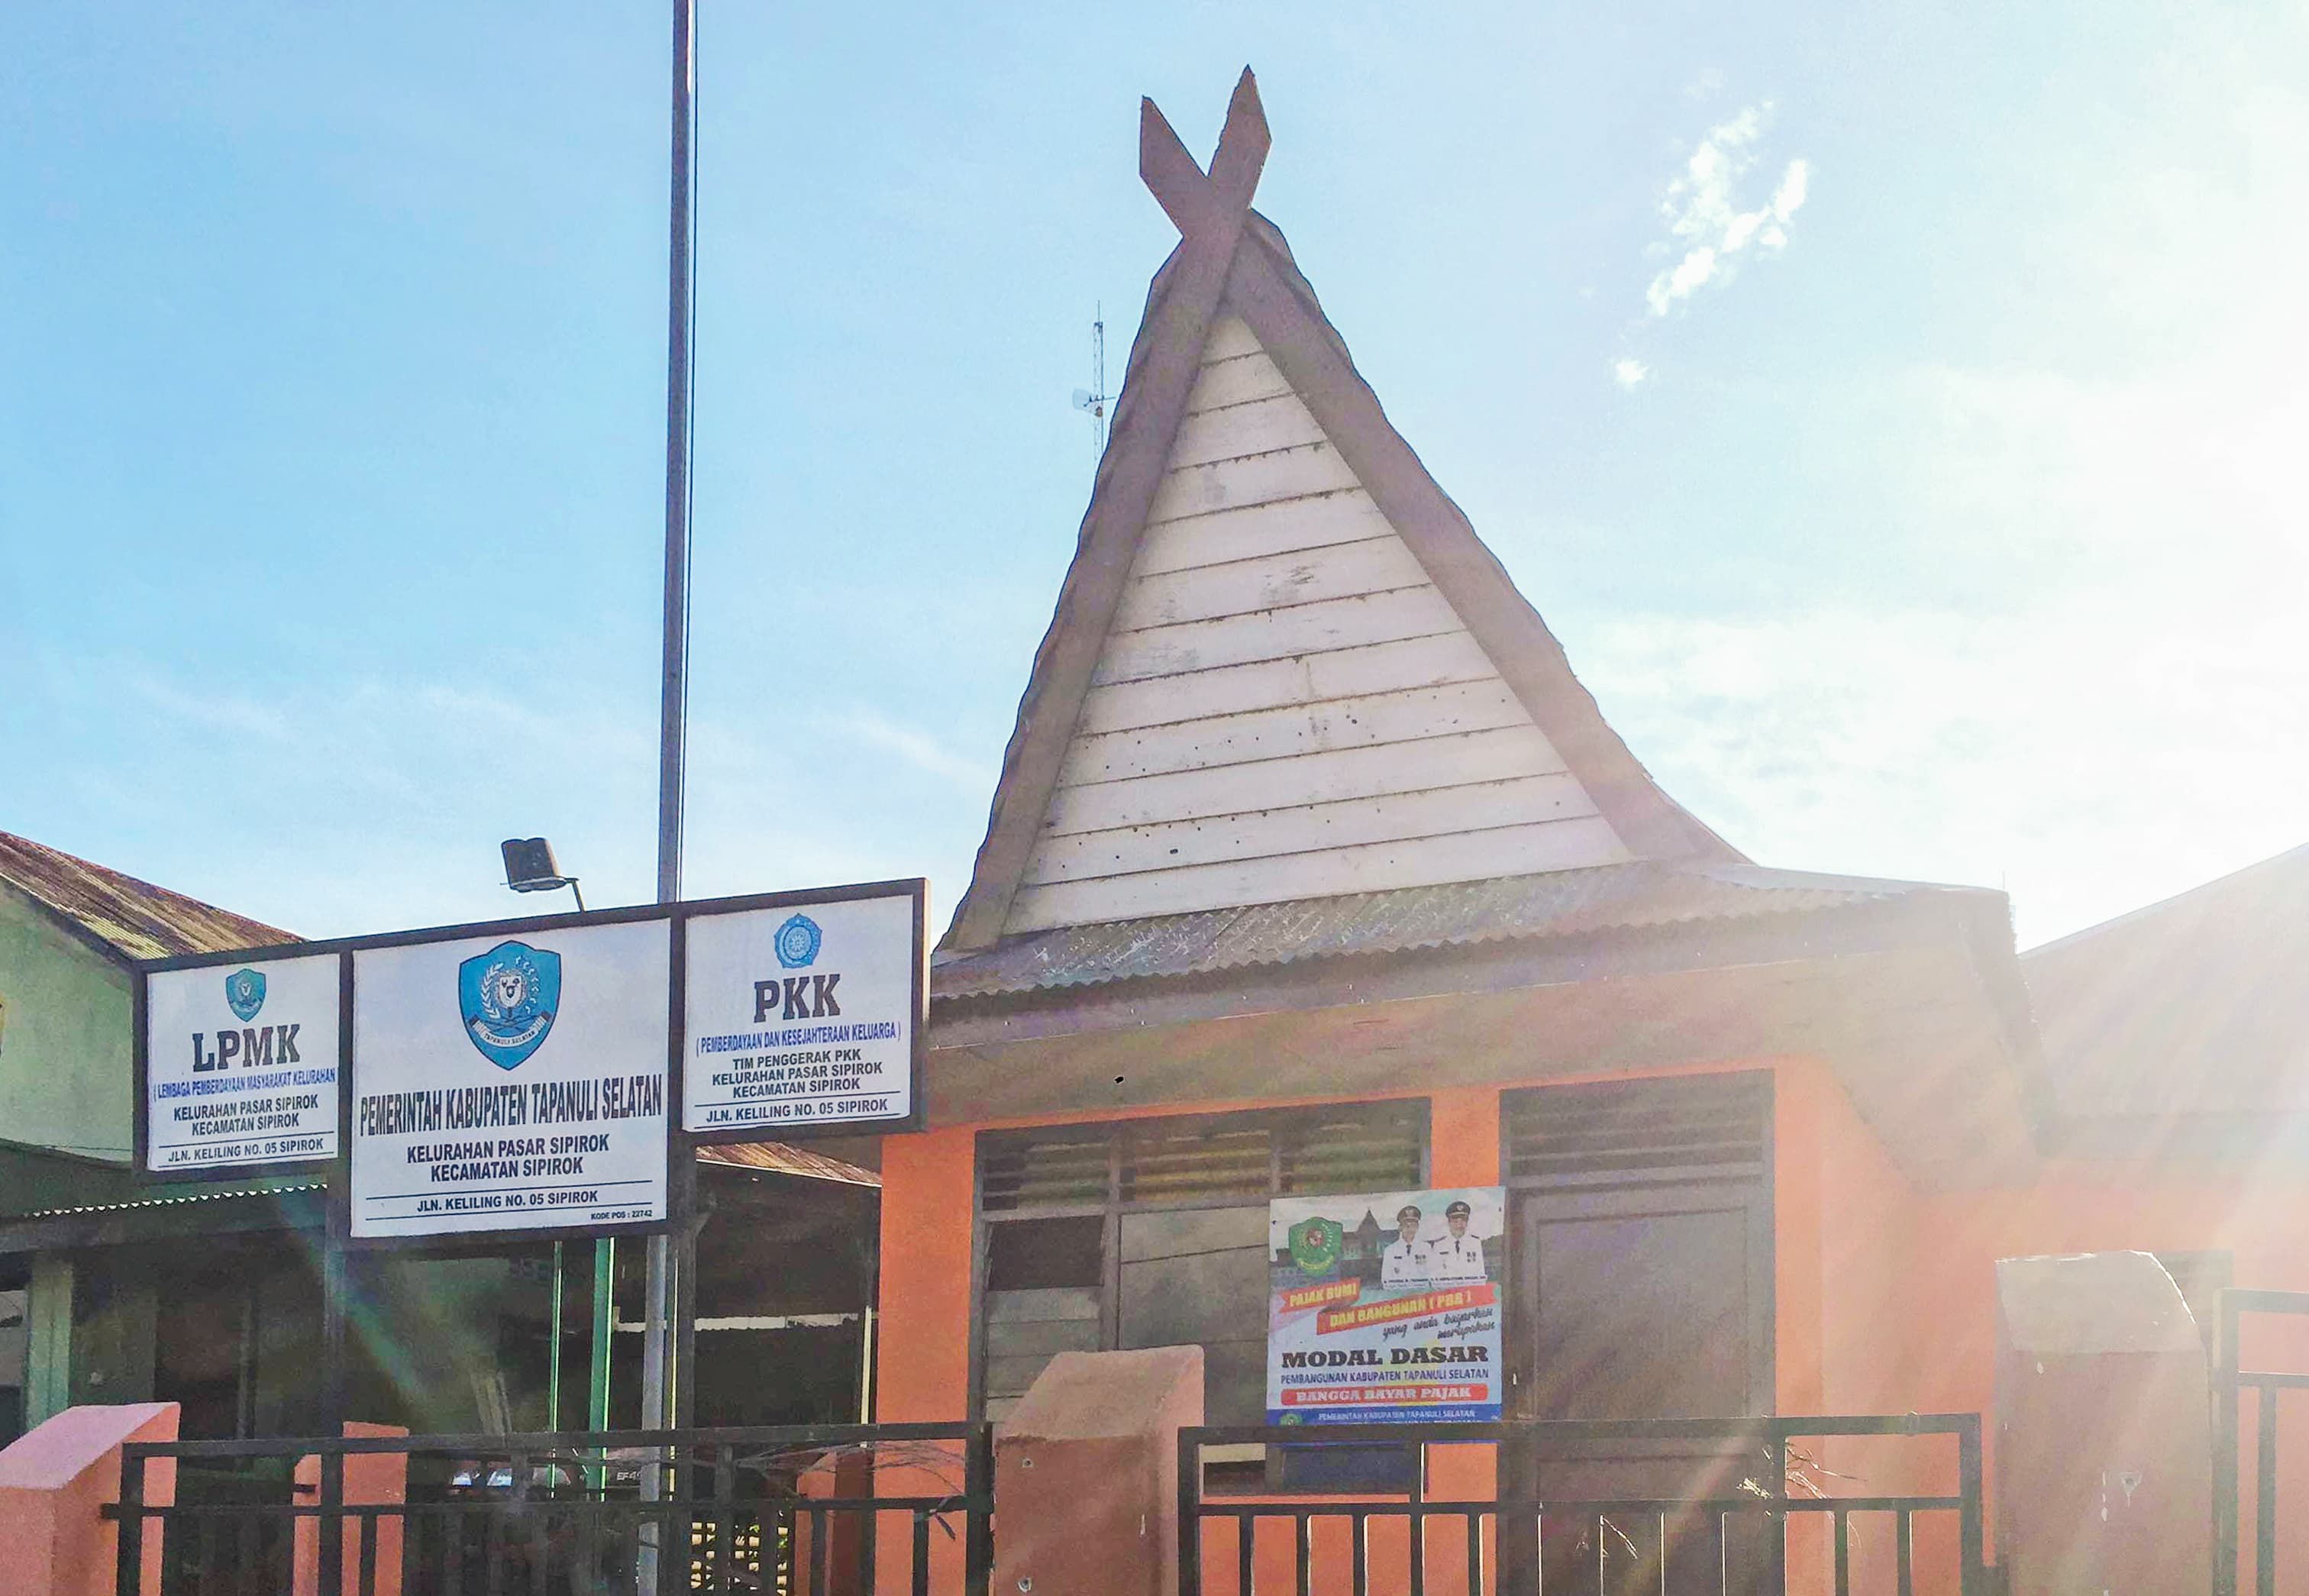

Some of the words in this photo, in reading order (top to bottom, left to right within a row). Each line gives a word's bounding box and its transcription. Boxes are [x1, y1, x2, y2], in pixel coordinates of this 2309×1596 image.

[754, 974, 840, 1023] PKK
[764, 1032, 780, 1048] DAN
[782, 1026, 849, 1046] KESEJAHTERAAN
[852, 1023, 896, 1040] KELUARGA
[192, 1024, 300, 1072] LPMK
[733, 1058, 754, 1070] TIM
[757, 1051, 831, 1068] PENGGERAK
[835, 1048, 861, 1061] PKK
[158, 1081, 190, 1098] LEMBAGA
[192, 1077, 244, 1095] PEMBERDAYAAN
[247, 1071, 291, 1090] MASYARAKAT
[293, 1068, 335, 1085] KELURAHAN
[712, 1071, 784, 1085] KELURAHAN
[788, 1066, 828, 1079] PASAR
[832, 1062, 883, 1075] SIPIROK
[733, 1082, 805, 1098] KECAMATAN
[809, 1078, 861, 1091] SIPIROK
[174, 1103, 237, 1121] KELURAHAN
[240, 1098, 272, 1115] PASAR
[276, 1094, 318, 1110] SIPIROK
[360, 1090, 441, 1137] PEMERINTAH
[446, 1084, 527, 1130] KABUPATEN
[532, 1079, 598, 1124] TAPANULI
[602, 1074, 662, 1118] SELATAN
[706, 1110, 732, 1123] JLN.
[736, 1106, 790, 1120] KELILING
[795, 1104, 815, 1115] NO.
[820, 1103, 834, 1113] 05
[838, 1099, 887, 1113] SIPIROK
[192, 1116, 254, 1136] KECAMATAN
[257, 1113, 299, 1129] SIPIROK
[169, 1147, 190, 1161] JLN.
[194, 1145, 241, 1160] KELILING
[244, 1144, 261, 1155] NO.
[265, 1143, 277, 1153] 05
[280, 1138, 324, 1152] SIPIROK
[407, 1140, 493, 1163] KELURAHAN
[499, 1137, 545, 1156] PASAR
[550, 1134, 609, 1154] SIPIROK
[431, 1160, 518, 1182] KECAMATAN
[523, 1156, 583, 1176] SIPIROK
[418, 1200, 441, 1212] JLN.
[446, 1196, 502, 1210] KELILING
[505, 1194, 525, 1206] NO.
[530, 1193, 544, 1205] 05
[548, 1191, 597, 1203] SIPIROK
[1290, 1288, 1323, 1307] PAJAK
[1326, 1283, 1357, 1301] BUMI
[1330, 1312, 1352, 1326] DAN
[1358, 1300, 1426, 1322] BANGUNAN
[1383, 1324, 1407, 1342] yang
[1282, 1349, 1383, 1368] MODAL
[1390, 1346, 1488, 1365] DASAR
[1281, 1371, 1347, 1384] PEMBANGUNAN
[1350, 1371, 1401, 1381] KABUPATEN
[1404, 1370, 1446, 1380] TAPANULI
[1449, 1368, 1488, 1379] SELATAN
[1297, 1390, 1359, 1401] BANGGA
[1364, 1388, 1416, 1400] BAYAR
[1420, 1387, 1471, 1398] PAJAK
